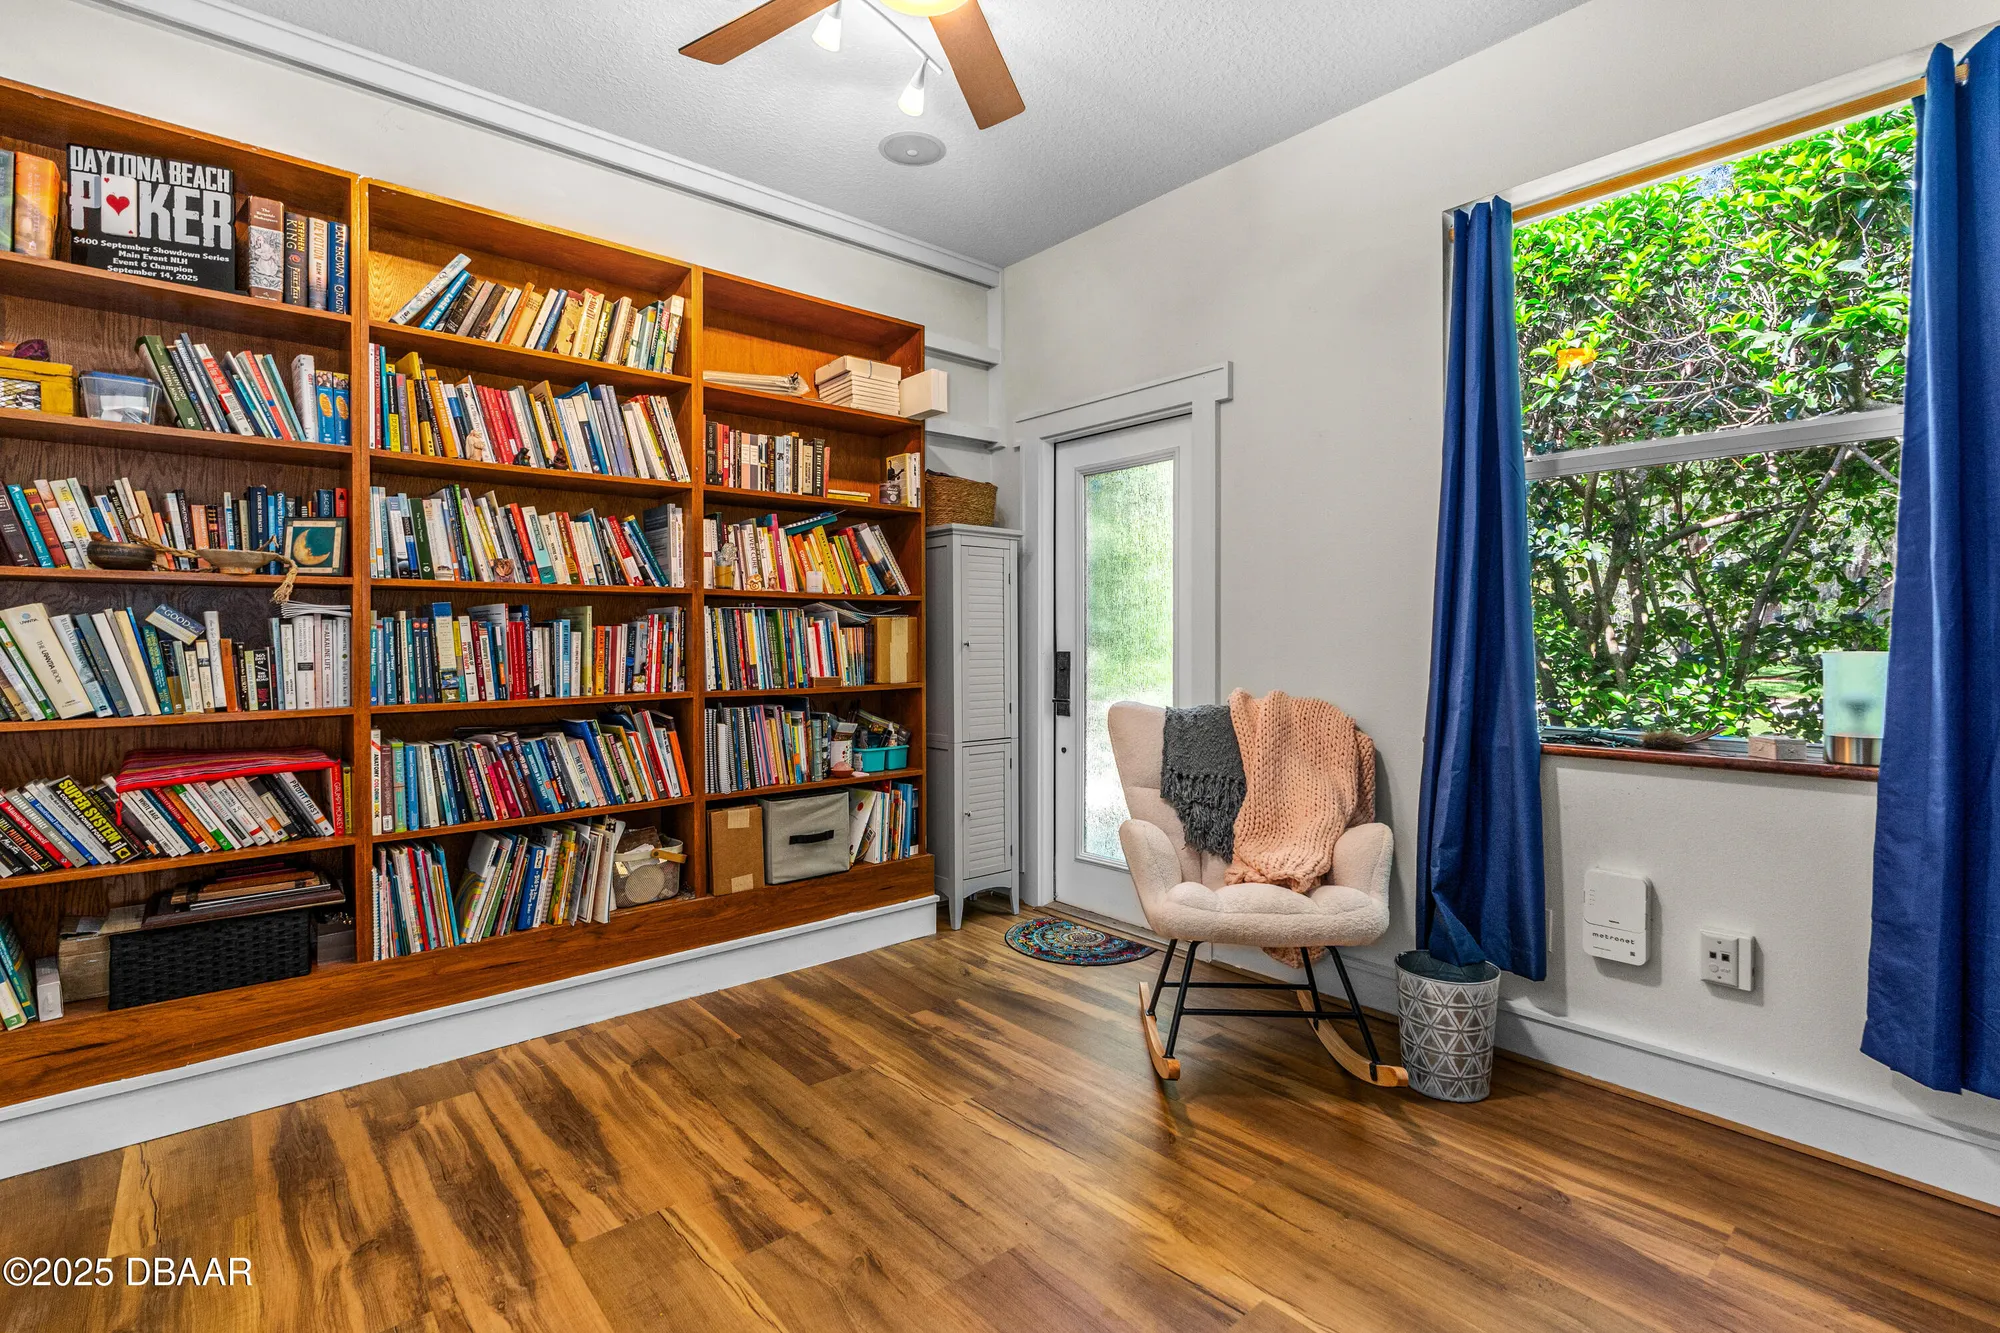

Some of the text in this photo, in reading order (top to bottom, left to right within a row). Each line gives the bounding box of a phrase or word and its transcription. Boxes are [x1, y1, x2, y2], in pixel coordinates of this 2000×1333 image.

[70, 145, 230, 193] DAYTONA BEACH
[73, 237, 229, 262] $400 September Showdown Series
[286, 219, 298, 250] KING
[297, 221, 305, 252] STEPHEN
[313, 221, 324, 261] DEVOTION
[113, 258, 138, 266] Event
[150, 261, 193, 273] Champion
[118, 250, 140, 258] Main
[143, 254, 167, 263] Event
[334, 224, 345, 313] DAN BROWN ORIGIN
[107, 265, 198, 282] September 14, 2025
[438, 293, 455, 310] LOSE
[424, 309, 442, 327] WELL
[160, 365, 179, 401] WESTERN MIND
[167, 365, 187, 400] EASTERN BODY
[68, 507, 78, 521] Beck
[180, 500, 188, 522] COMPLETION
[164, 609, 190, 627] GOOD
[36, 640, 63, 684] THE URANTIA BOOK
[551, 760, 565, 796] Hidden Treasure
[576, 764, 585, 775] PLOT
[58, 779, 122, 844] SUPER SYSTEM
[138, 798, 160, 821] WHITE RAGE
[288, 779, 319, 816] PROFIT FIRST
[5, 805, 49, 844] Managing Yourself
[34, 803, 75, 842] Emotional Intelligence
[59, 793, 75, 811] COURSE
[79, 815, 93, 830] POWER
[91, 828, 106, 843] POKER
[334, 806, 342, 829] MONKEY
[1592, 932, 1635, 945] metronet
